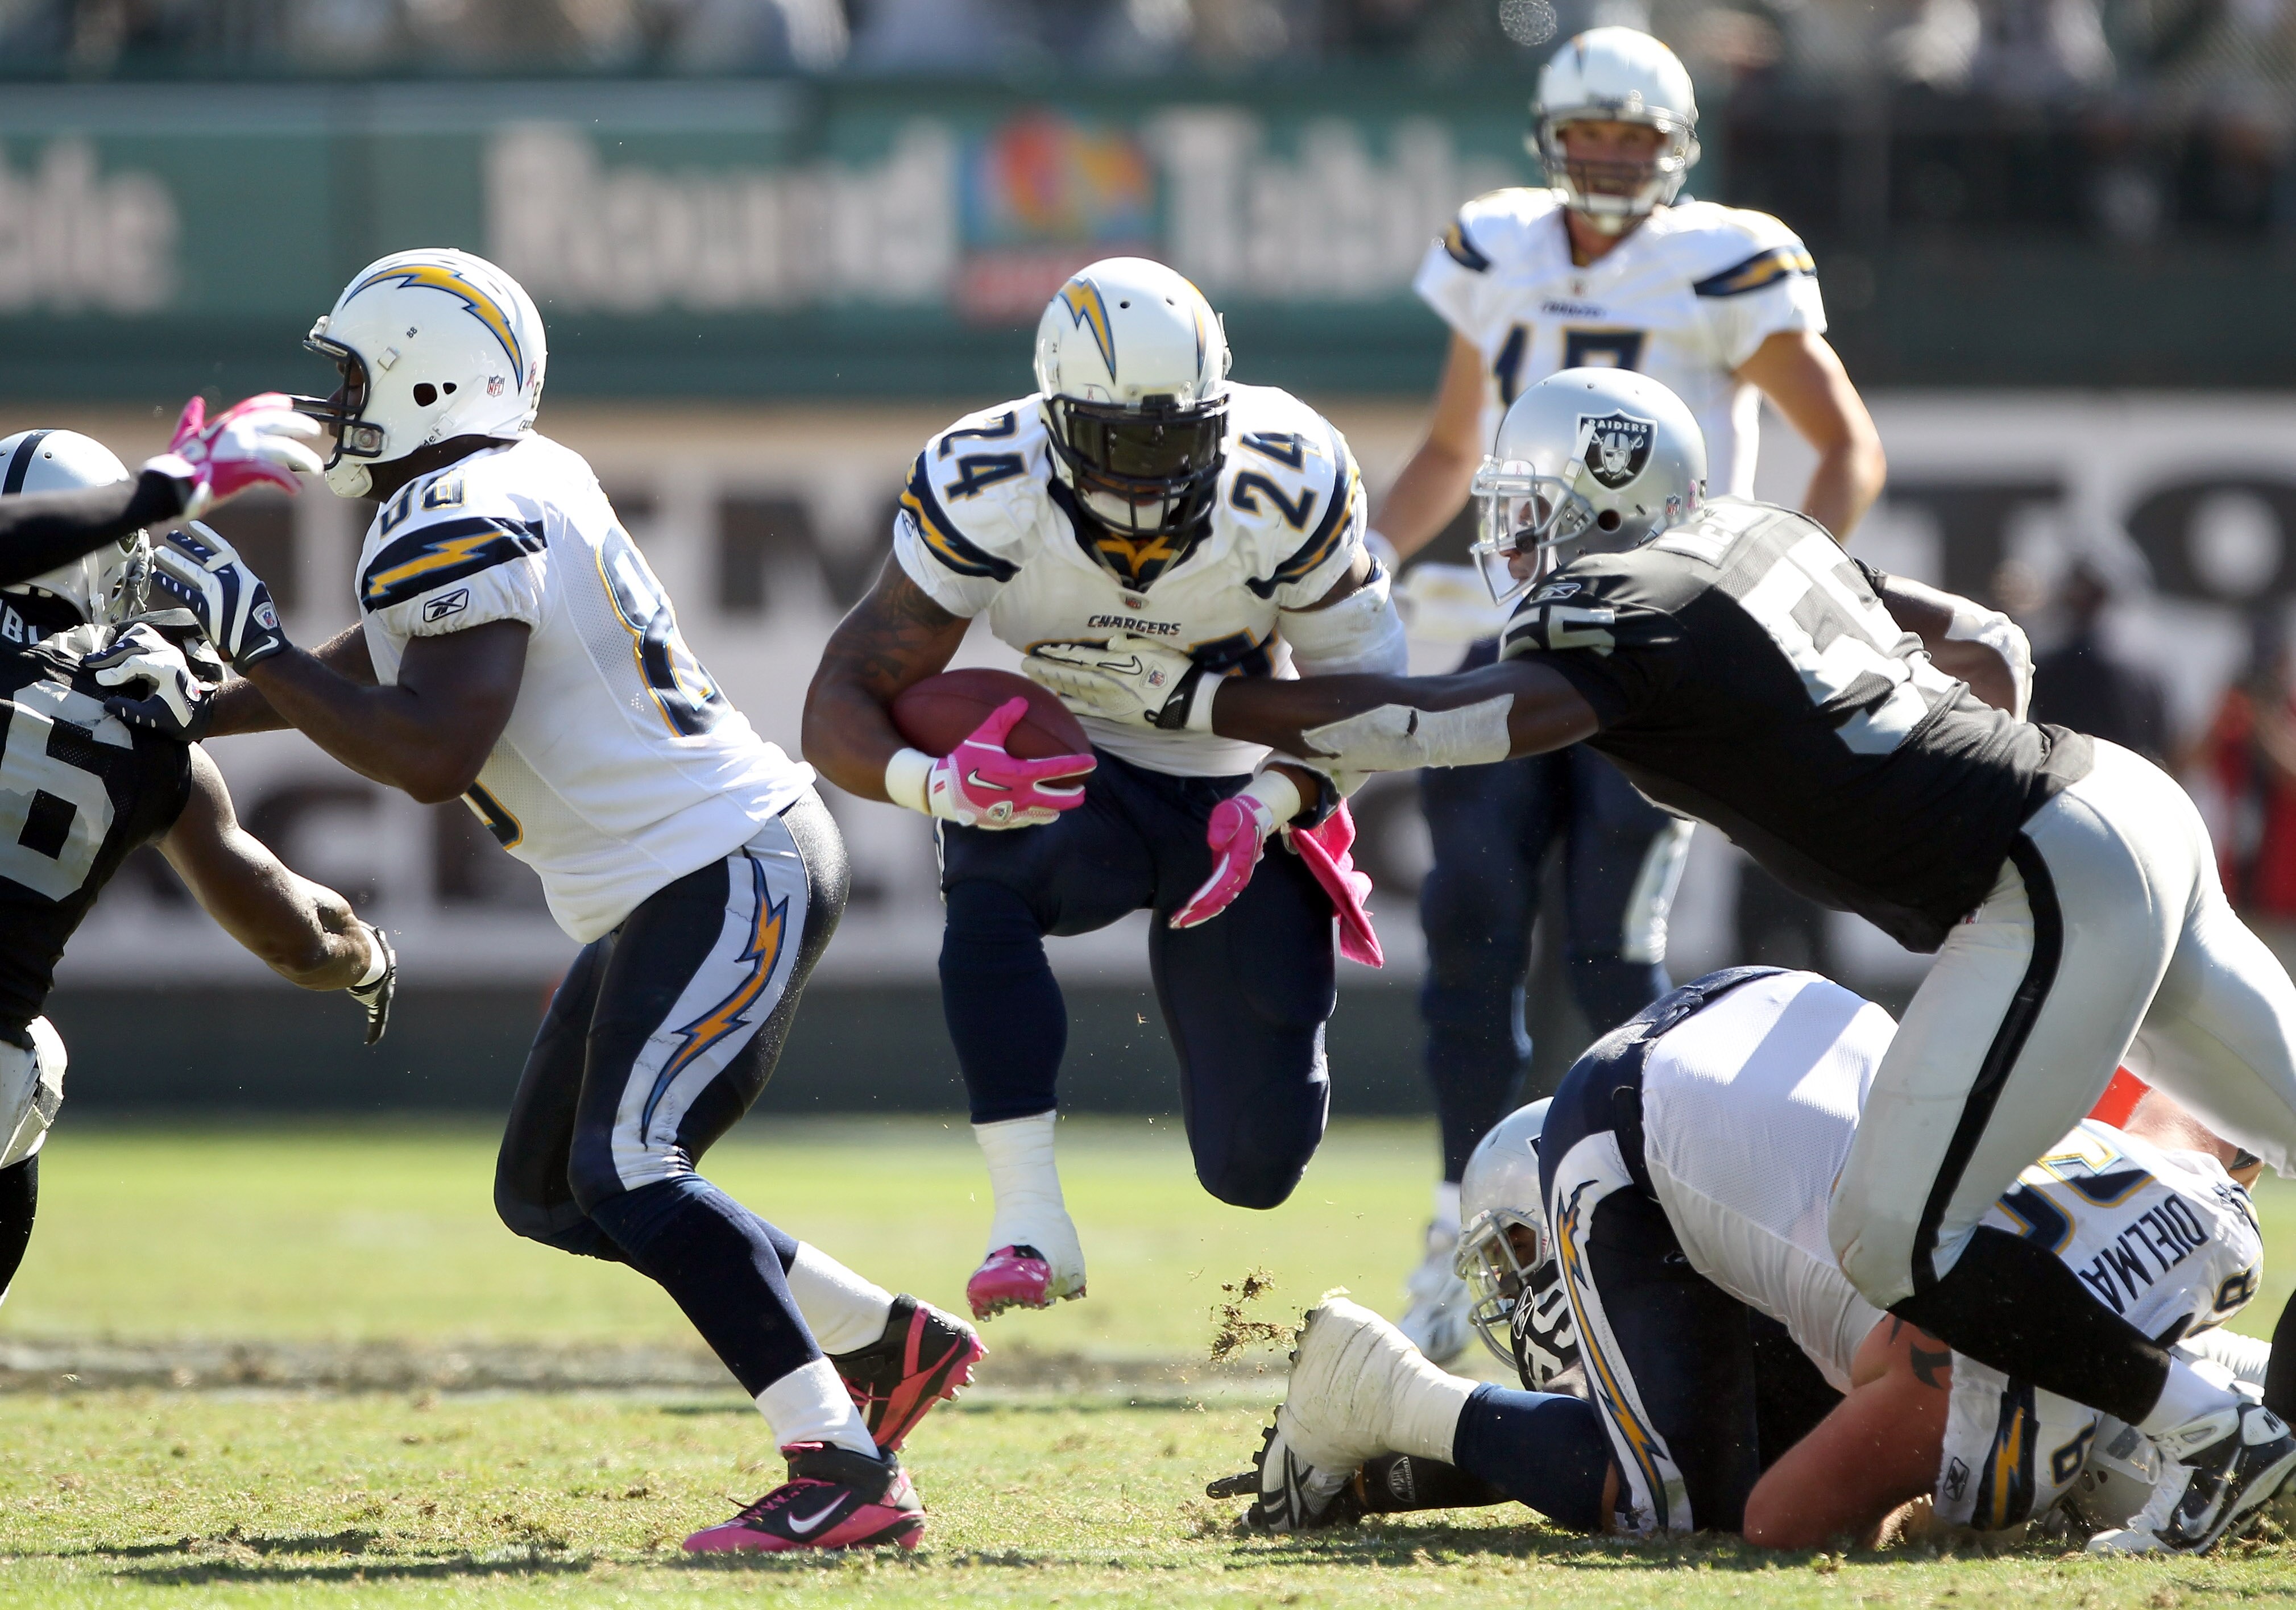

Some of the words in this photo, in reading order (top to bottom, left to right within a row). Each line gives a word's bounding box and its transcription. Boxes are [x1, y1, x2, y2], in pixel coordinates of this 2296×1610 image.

[406, 326, 418, 338] 88
[1588, 418, 1648, 433] RAIDERS
[937, 409, 1030, 504] 24
[1228, 430, 1323, 534] 24
[0, 600, 108, 661] BLEY
[1087, 614, 1182, 636] CHARGERS
[1740, 530, 1956, 754] 55
